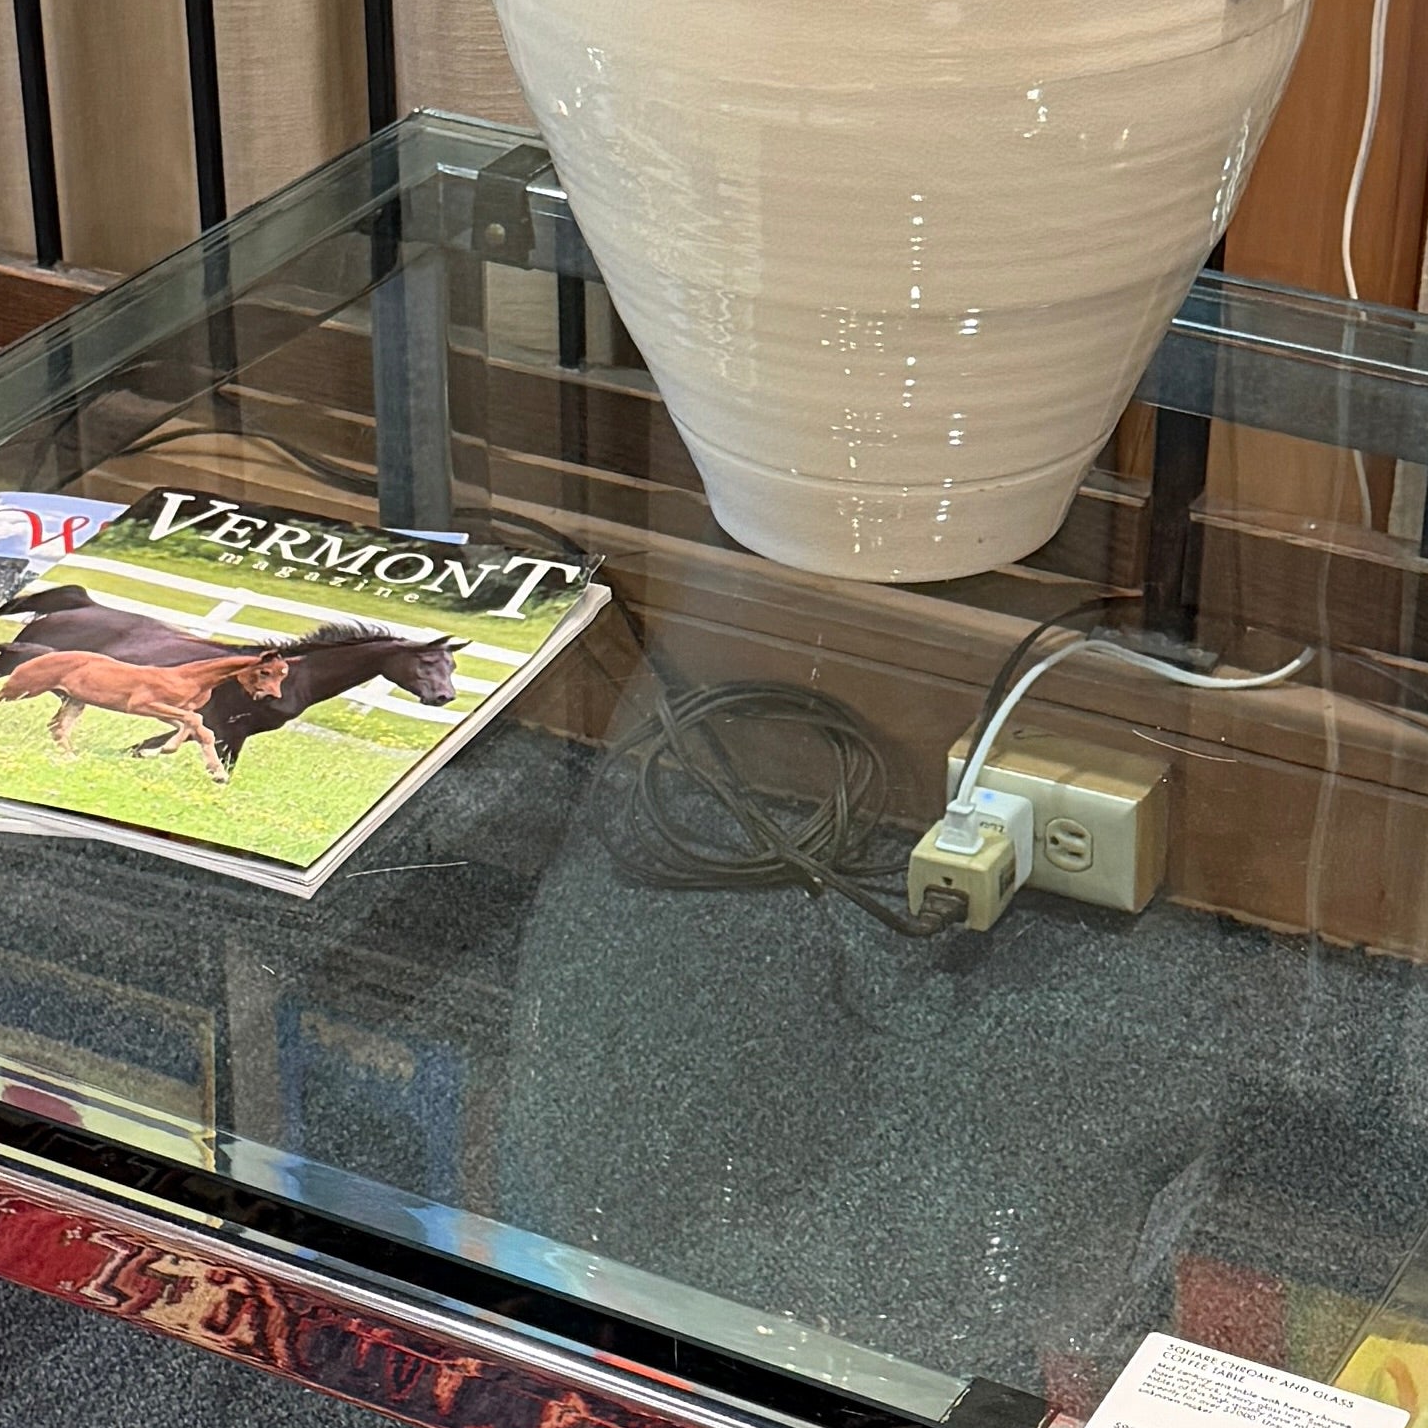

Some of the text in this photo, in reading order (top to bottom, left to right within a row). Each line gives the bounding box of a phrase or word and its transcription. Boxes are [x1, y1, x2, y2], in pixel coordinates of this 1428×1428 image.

[146, 492, 580, 620] VERMONT
[218, 549, 420, 603] magazine
[1163, 1352, 1245, 1383] COFFEE TABLE
[1167, 1344, 1353, 1408] SQUARE CHROME AND GLASS
